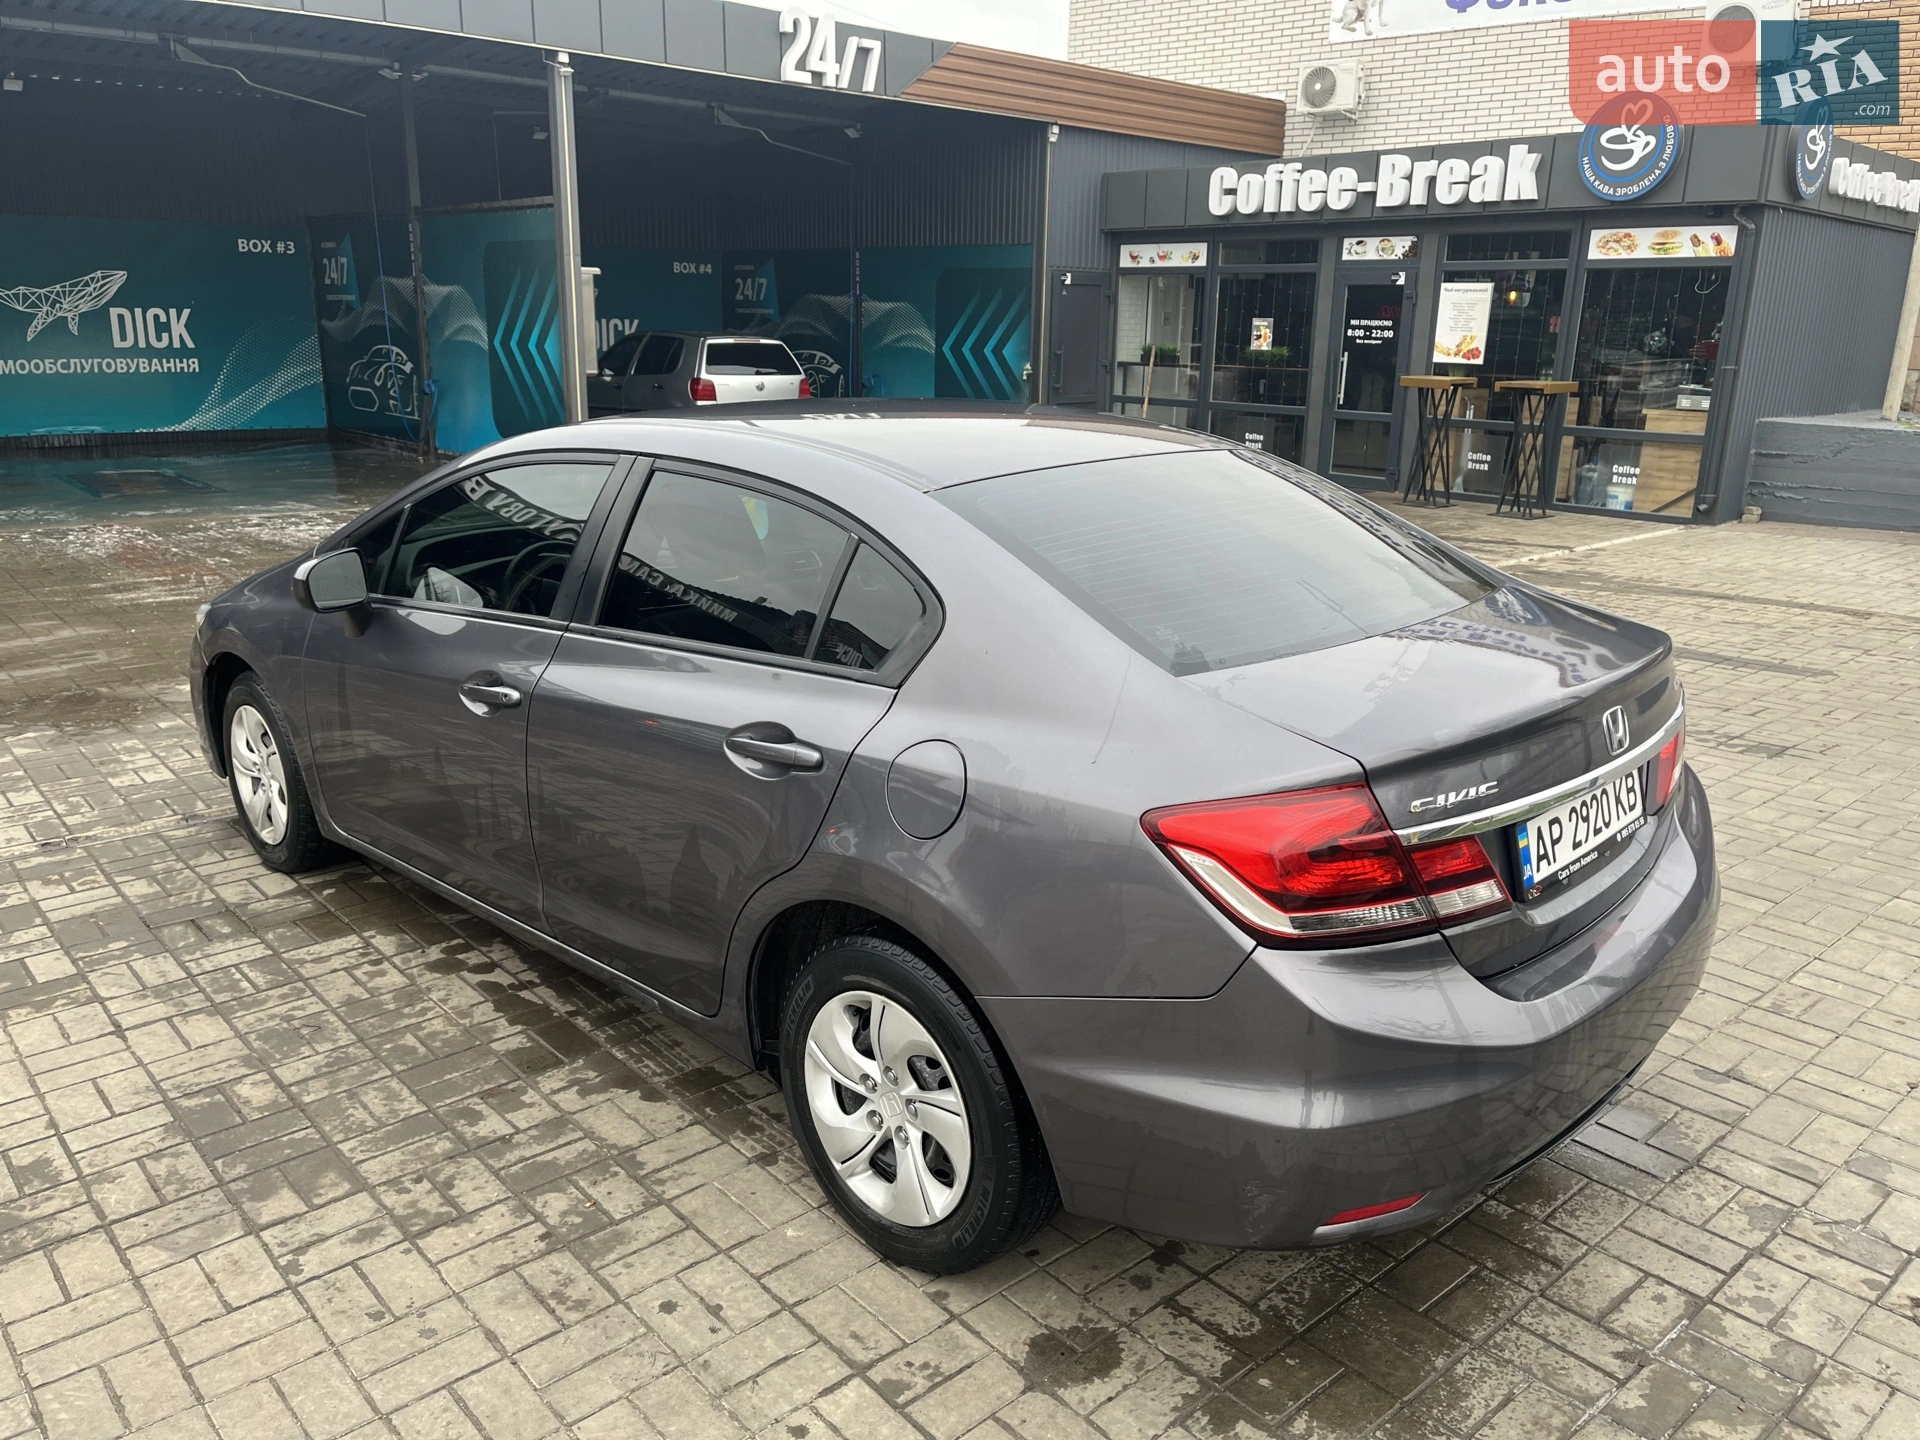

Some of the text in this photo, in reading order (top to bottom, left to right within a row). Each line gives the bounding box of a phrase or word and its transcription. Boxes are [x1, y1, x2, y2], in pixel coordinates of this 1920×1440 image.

[778, 6, 881, 93] 24/7
[1208, 144, 1544, 217] Coffee-Break
[1582, 156, 1596, 184] НАША
[1593, 181, 1614, 195] КАВА
[1615, 169, 1662, 196] ЗРОБЛЕНА
[237, 239, 296, 255] BOX #3
[322, 256, 348, 286] 24/7
[673, 261, 712, 275] BOX #4
[735, 276, 768, 301] 24/7
[109, 307, 196, 349] DICK
[1347, 328, 1364, 337] 8:00
[1371, 329, 1394, 338] 22:00
[1245, 432, 1264, 441] Coffee
[1467, 451, 1491, 461] Coffee
[1467, 461, 1489, 471] Break
[1612, 464, 1640, 475] Coffee
[1612, 475, 1638, 485] Break
[1409, 780, 1499, 813] CIVIC
[1536, 771, 1638, 874] AP 2920 KB
[1557, 850, 1598, 880] Cars from America
